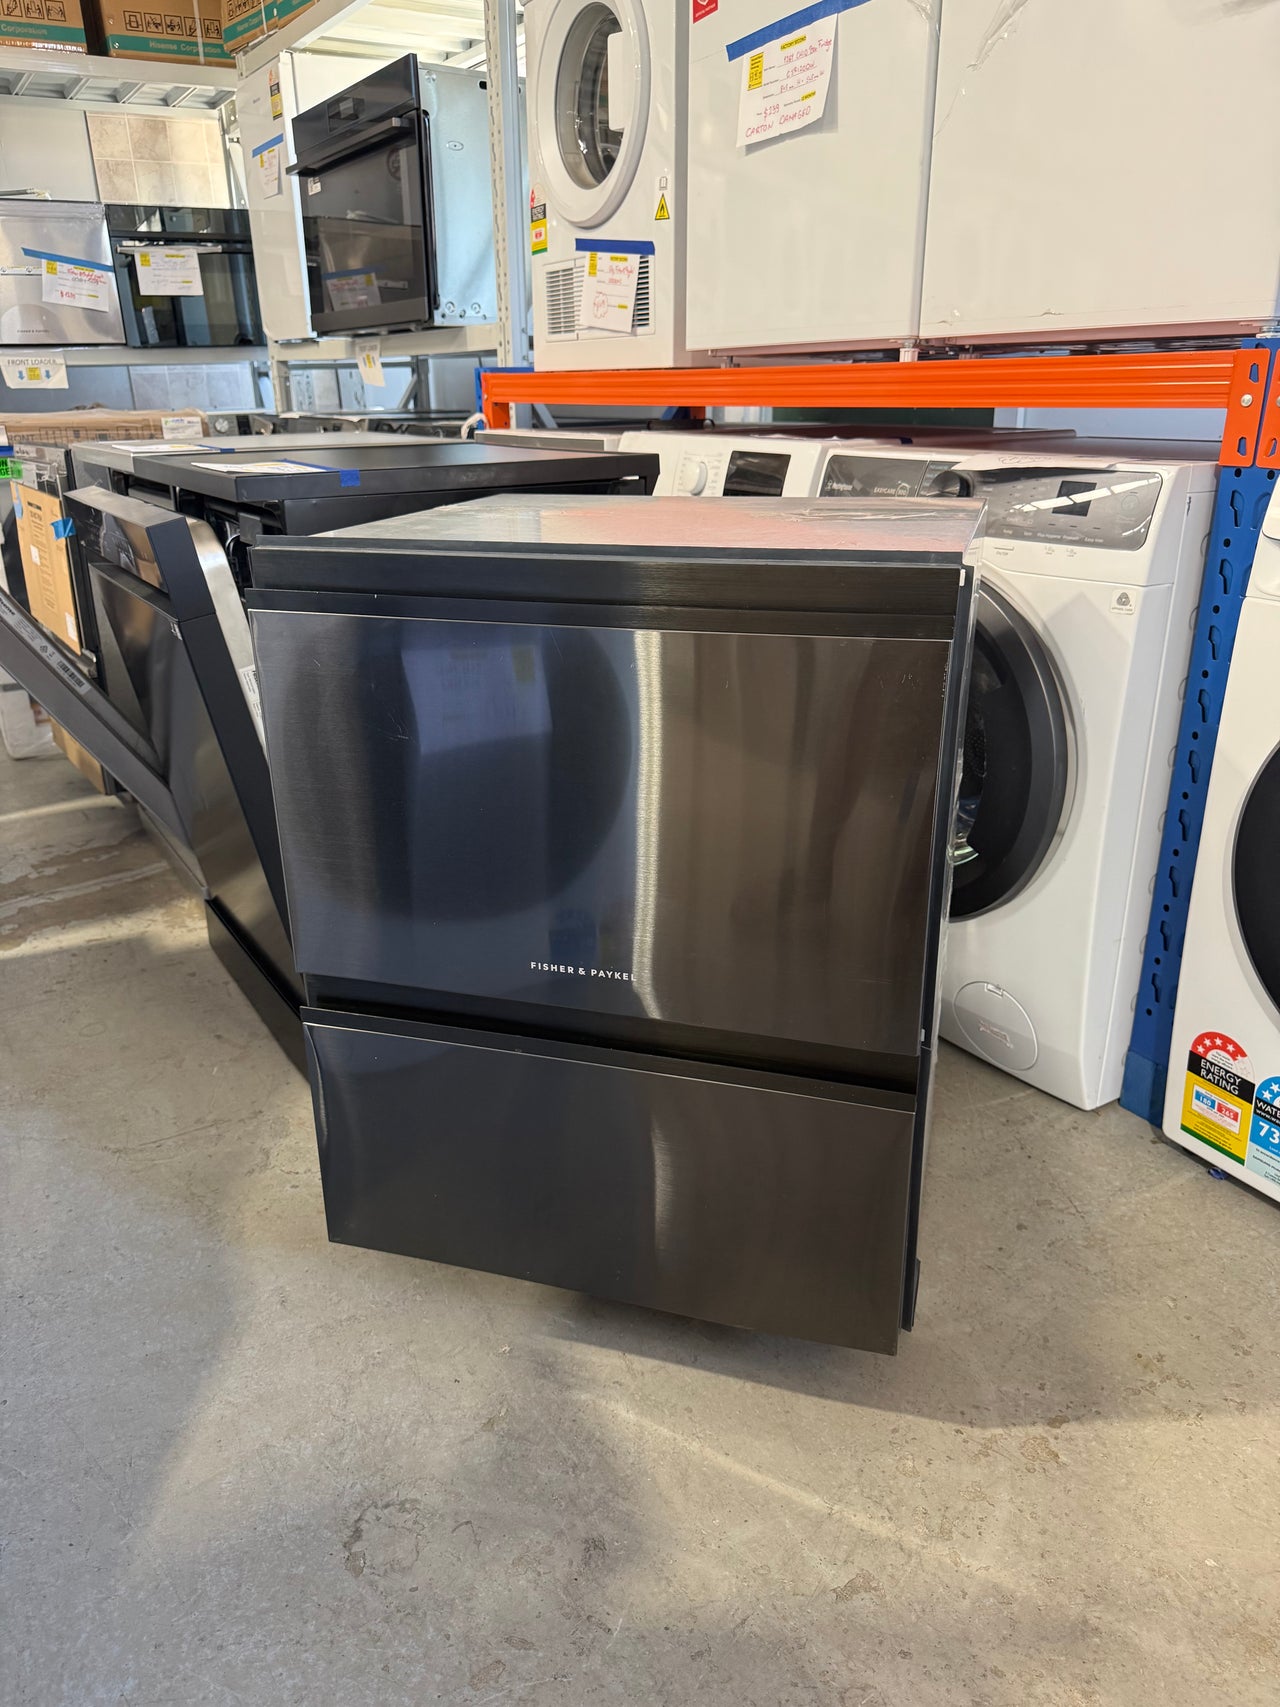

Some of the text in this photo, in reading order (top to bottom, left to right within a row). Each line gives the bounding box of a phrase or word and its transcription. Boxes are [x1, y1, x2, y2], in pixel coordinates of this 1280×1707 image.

[745, 122, 774, 139] CARTON
[530, 961, 637, 982] FISHER & PAYKEL
[1200, 1058, 1242, 1087] ENERGY
[1200, 1068, 1240, 1096] RATING
